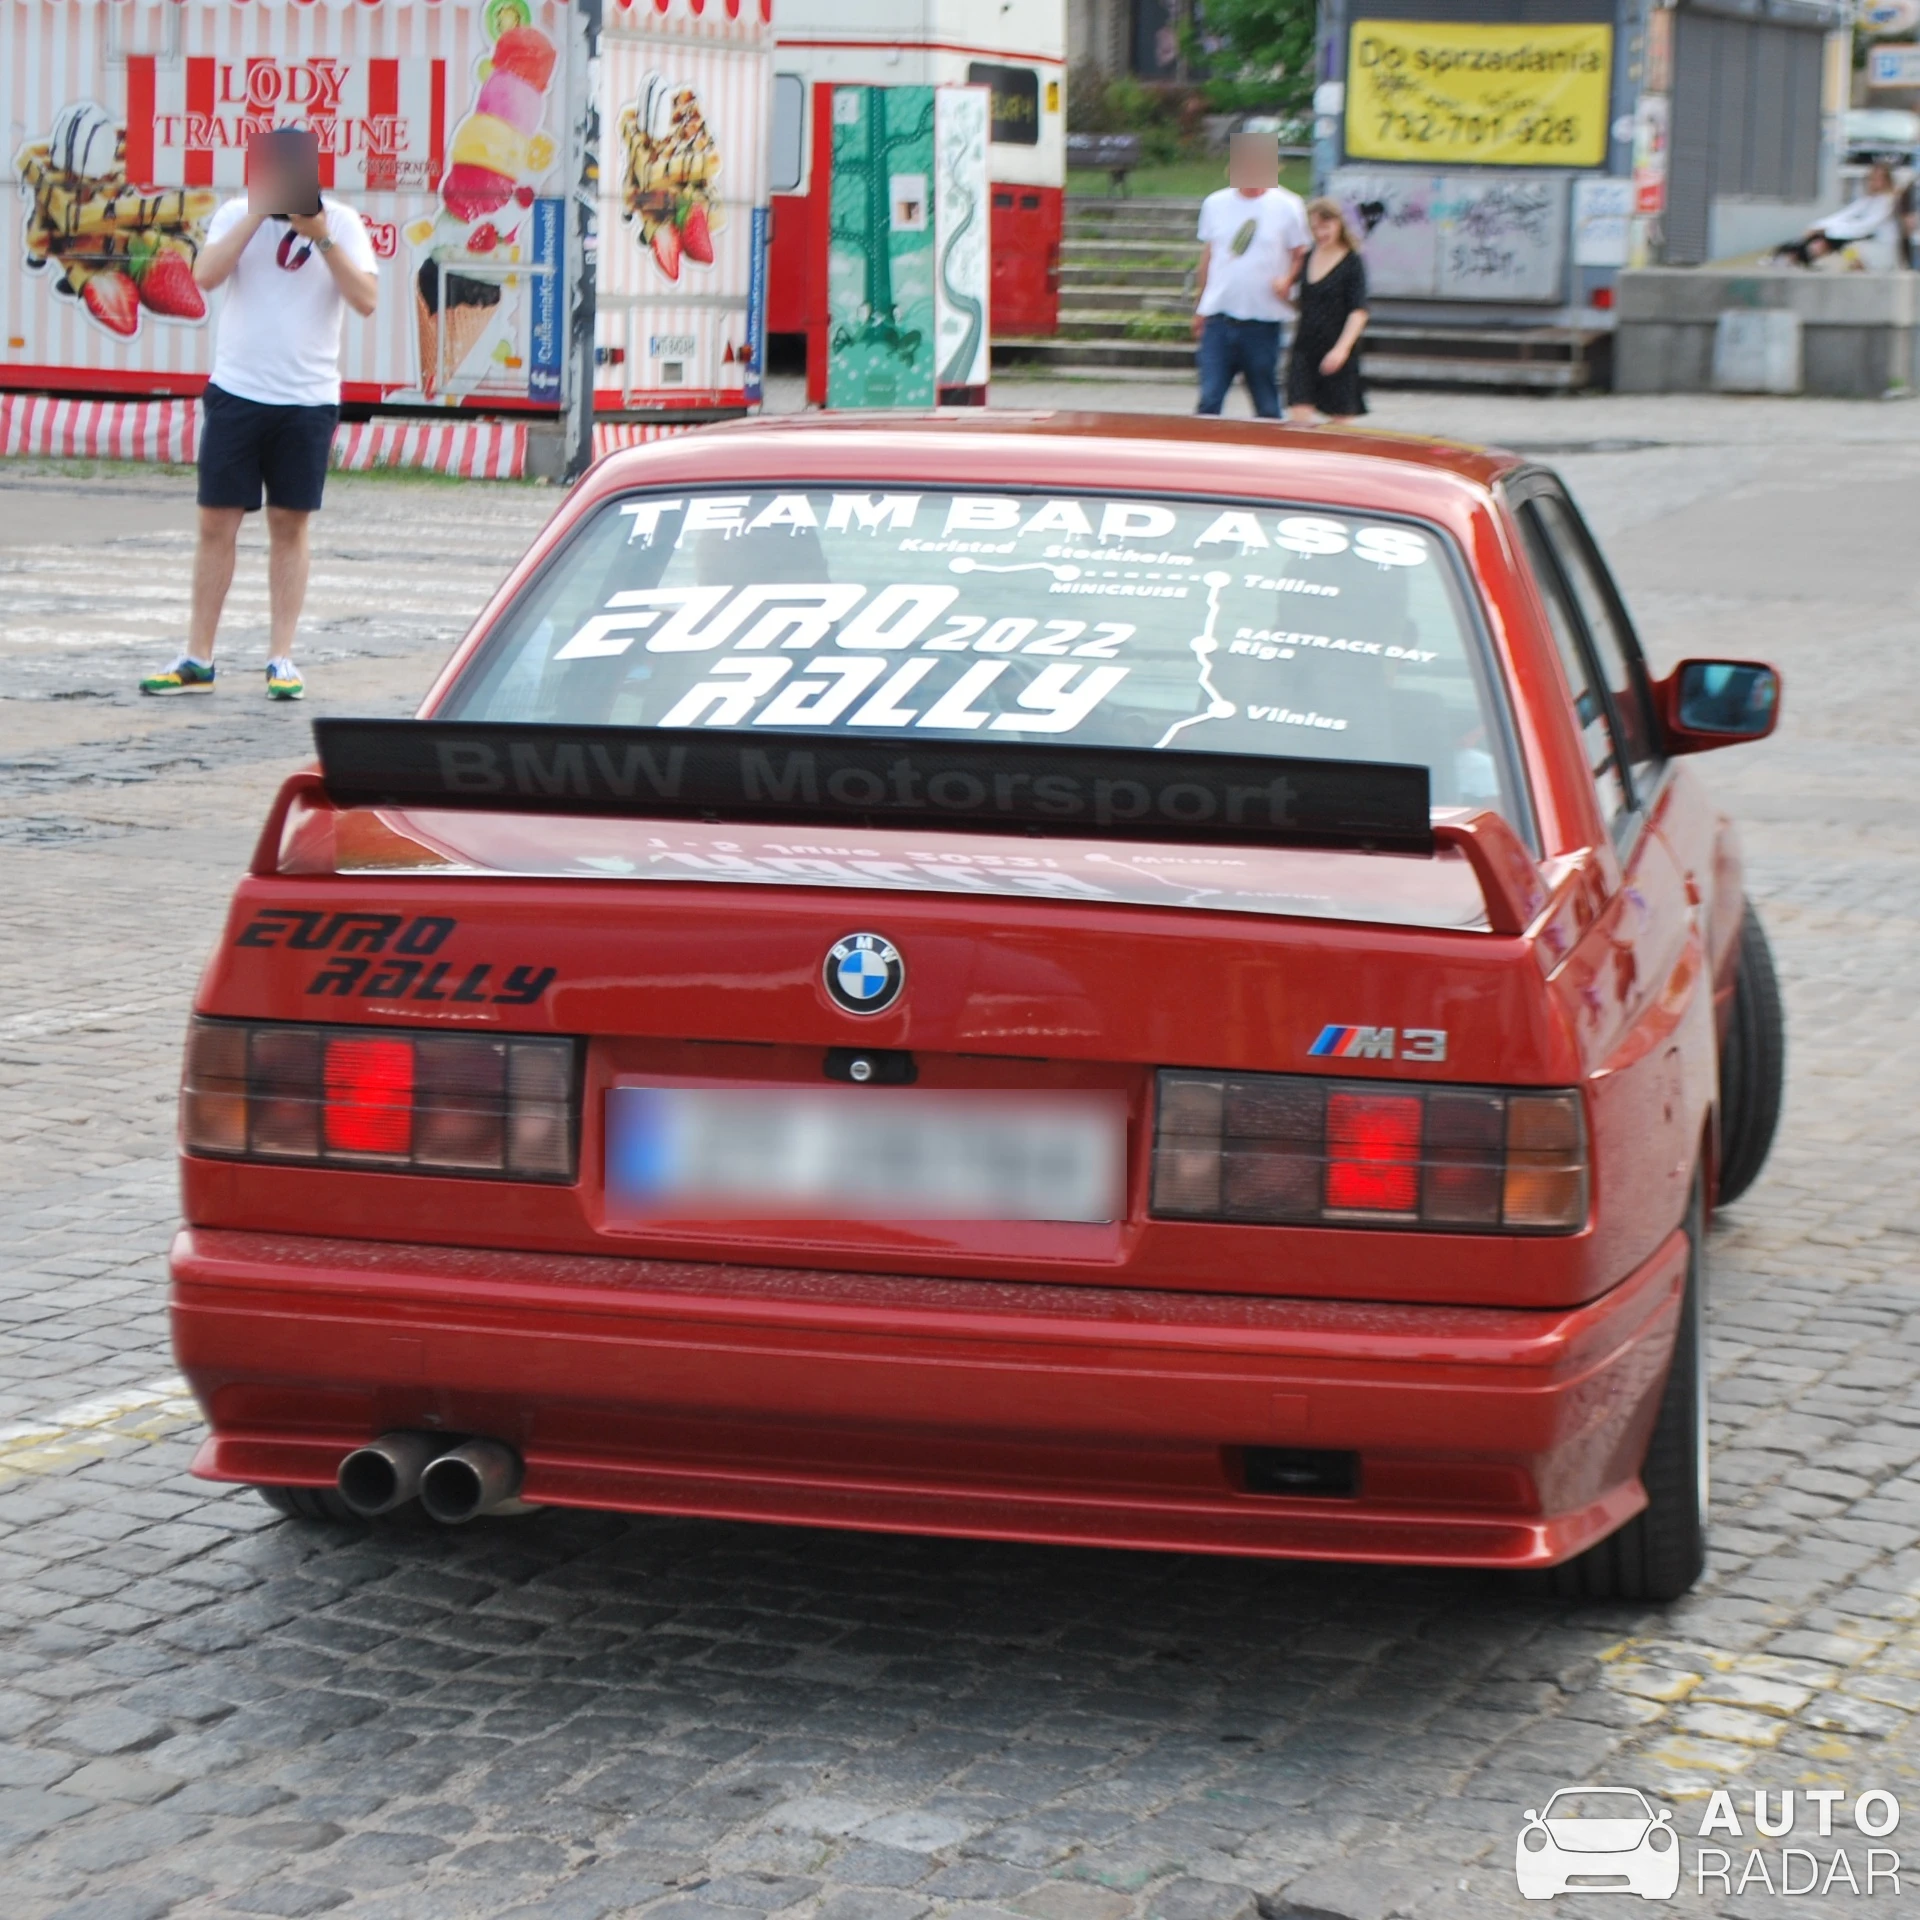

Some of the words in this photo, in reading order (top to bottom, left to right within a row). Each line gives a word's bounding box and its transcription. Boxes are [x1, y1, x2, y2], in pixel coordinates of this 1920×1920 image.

[1358, 37, 1403, 69] Do
[1414, 44, 1601, 77] sprzedania
[218, 61, 350, 107] LODY
[620, 494, 922, 547] TEAM
[944, 497, 1177, 546] BAD
[1195, 510, 1430, 567] ASS
[898, 538, 1017, 554] Karlstad
[1042, 545, 1194, 566] Stockholm
[1048, 582, 1189, 599] MINICRUISE
[1244, 574, 1340, 597] Tallinn
[553, 583, 960, 660] EURO
[921, 615, 1137, 659] 2022
[1228, 639, 1295, 661] Riga
[1234, 627, 1382, 656] RACETRACK
[1384, 645, 1439, 662] DAY
[1247, 704, 1348, 731] Vilnius
[436, 740, 689, 797] BMW
[737, 746, 1299, 827] Motorsport
[235, 908, 457, 955] EURO
[832, 935, 899, 963] BMW
[1342, 1025, 1448, 1062] M3
